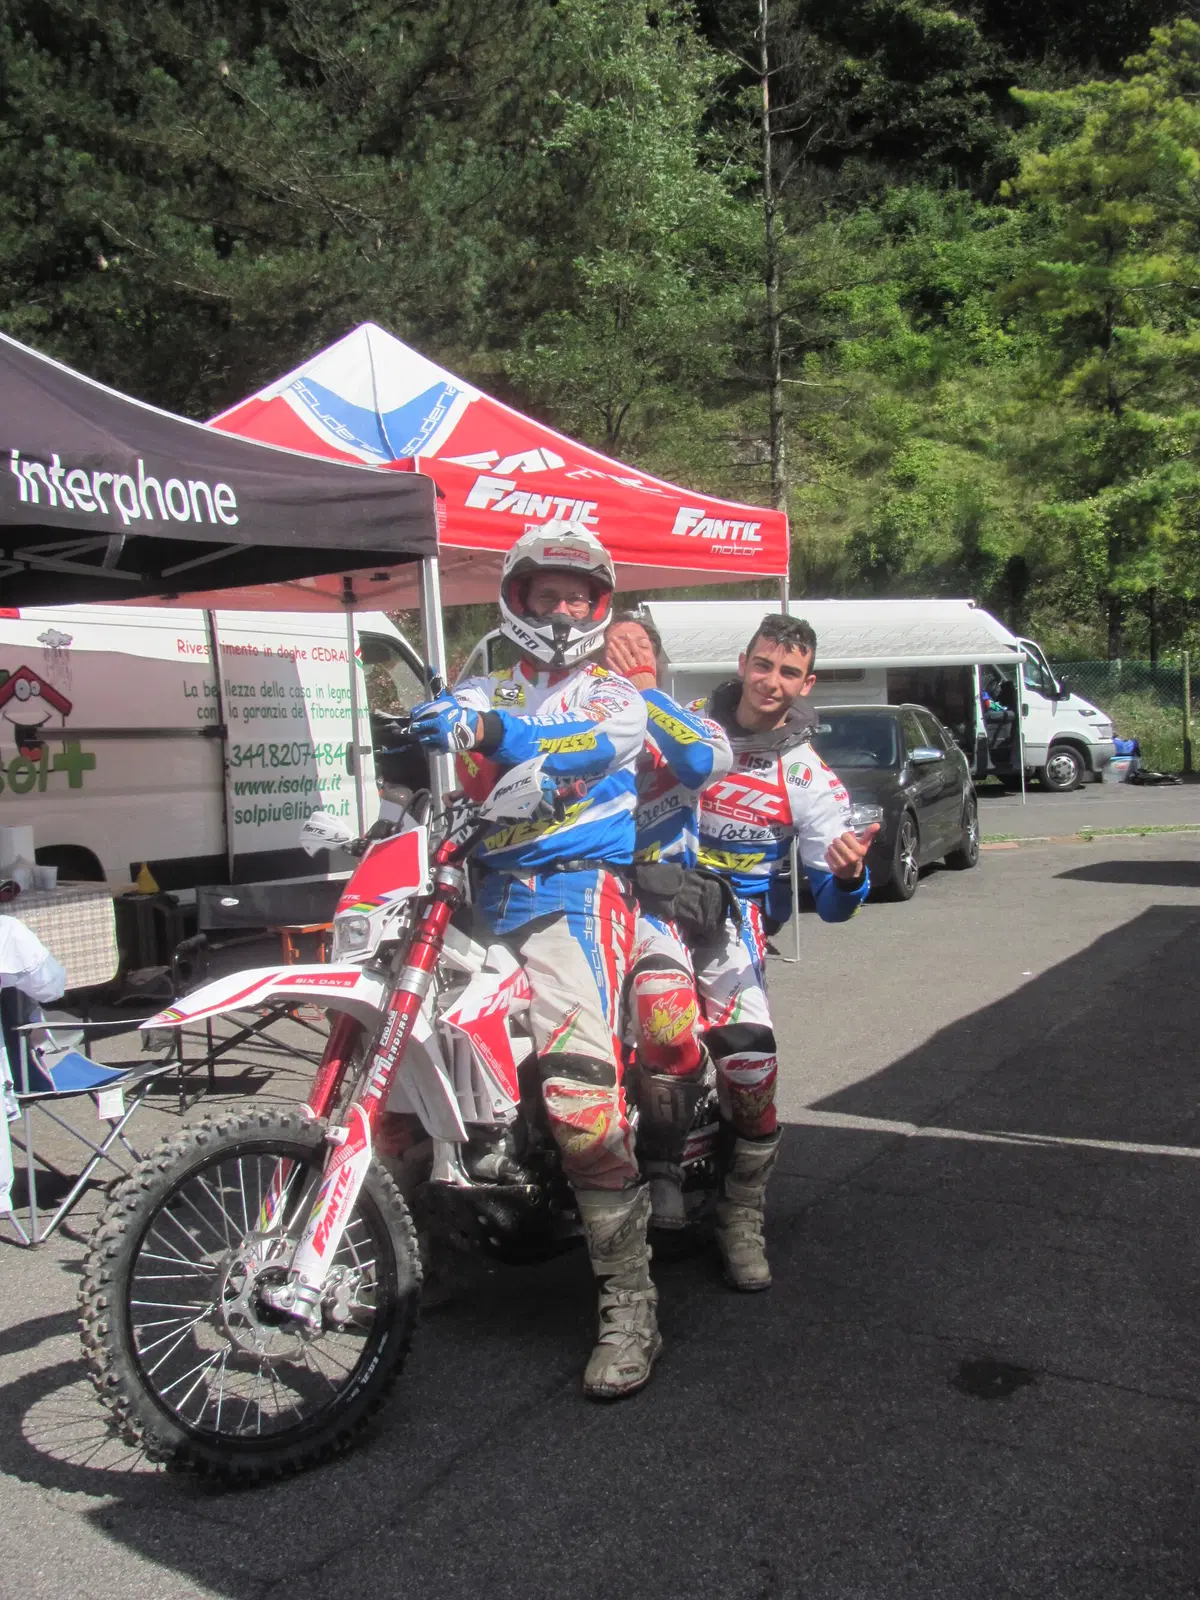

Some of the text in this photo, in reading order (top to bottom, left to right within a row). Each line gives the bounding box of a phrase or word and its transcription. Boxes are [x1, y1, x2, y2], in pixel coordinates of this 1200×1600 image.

[10, 449, 239, 526] interphone
[464, 474, 600, 525] FANTIC
[671, 507, 762, 542] FANTIC
[710, 544, 763, 557] motor
[512, 622, 539, 651] UFO
[575, 636, 596, 657] UFO
[177, 639, 258, 657] Rivesimento
[263, 643, 273, 657] in
[277, 644, 307, 664] doghe
[183, 680, 199, 698] La
[260, 681, 285, 698] della
[289, 687, 312, 698] casa
[315, 683, 325, 698] in
[197, 706, 217, 719] con
[228, 700, 239, 718] la
[243, 704, 287, 723] garanzia
[229, 742, 346, 768] 349.8207484
[234, 773, 342, 796] www.isolpiu.it
[493, 776, 532, 801] FANTIC
[706, 781, 785, 815] TIC
[319, 978, 352, 986] DAYS
[312, 1163, 352, 1258] FANTIC
